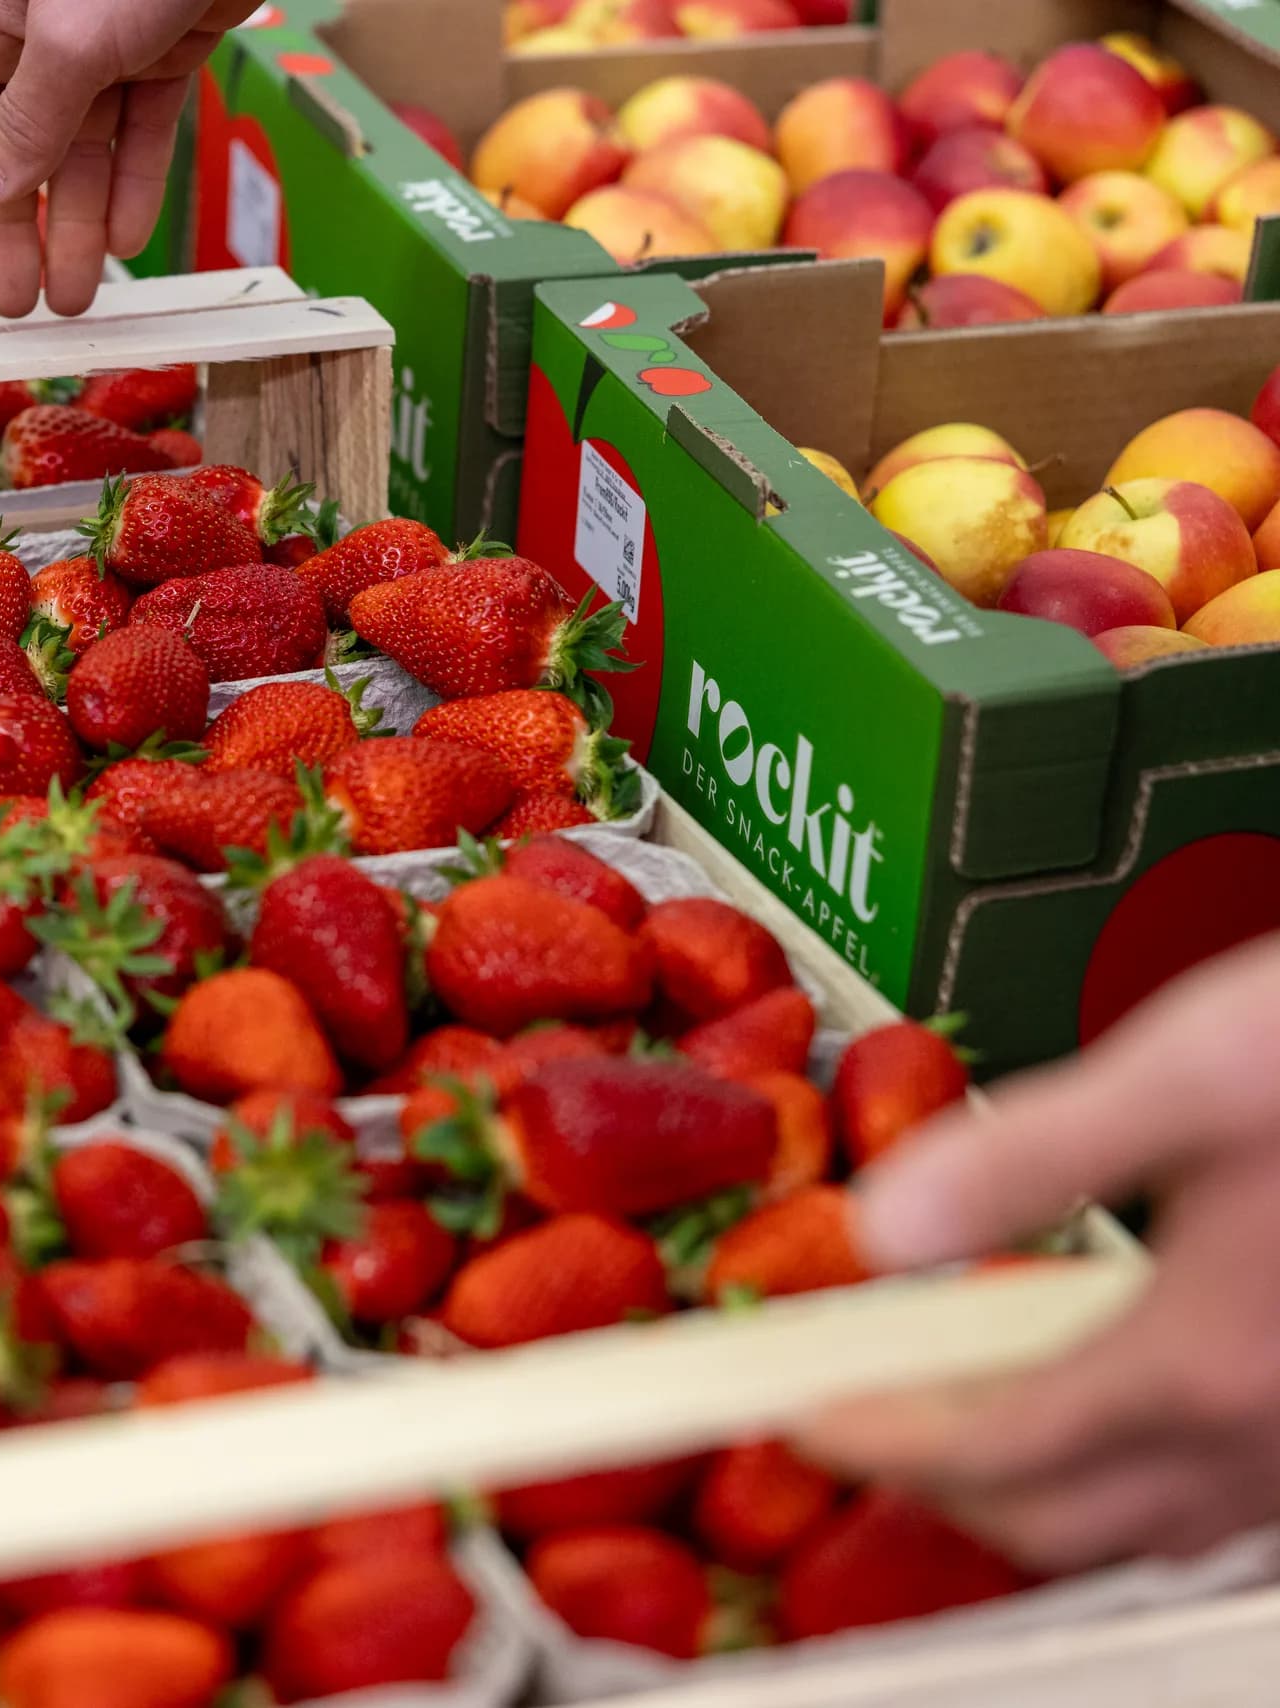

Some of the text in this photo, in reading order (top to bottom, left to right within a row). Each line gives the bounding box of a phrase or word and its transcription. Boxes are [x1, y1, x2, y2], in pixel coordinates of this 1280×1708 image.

[826, 550, 961, 645] rockit
[682, 747, 718, 807] DER
[687, 659, 884, 923] rockit
